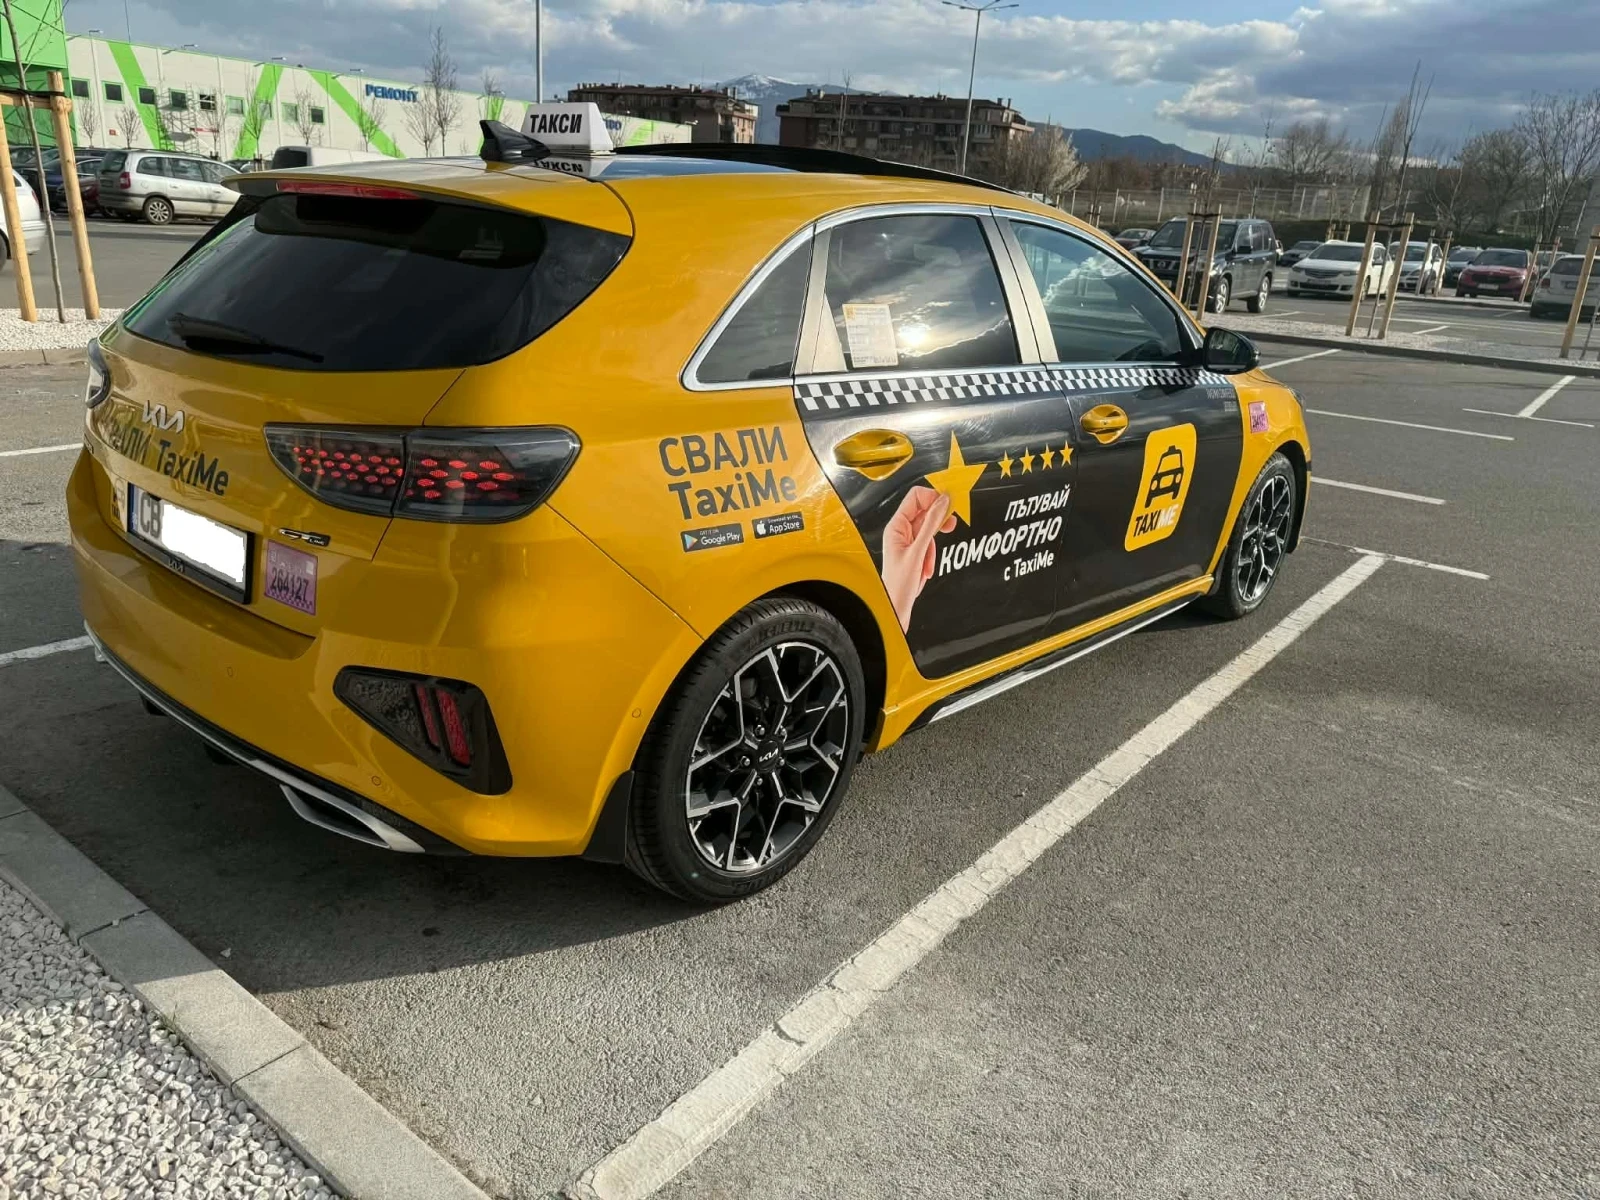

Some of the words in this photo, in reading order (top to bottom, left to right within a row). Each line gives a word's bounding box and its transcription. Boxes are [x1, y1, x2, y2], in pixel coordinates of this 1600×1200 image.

[366, 84, 418, 102] РЕМОНТ
[530, 113, 582, 133] ТАКСИ
[155, 439, 229, 496] TaxiMe
[658, 426, 788, 476] СВАЛИ
[668, 468, 797, 520] TaxiMe
[1004, 484, 1070, 521] ПЪТУВАЙ
[769, 523, 784, 534] App
[784, 520, 800, 531] Store
[1133, 504, 1179, 537] TAXIME
[701, 533, 726, 545] Google
[726, 532, 740, 542] Play
[938, 516, 1062, 577] КОМФОРТНО
[1014, 550, 1054, 578] TaxiMe
[270, 567, 309, 602] 264127
